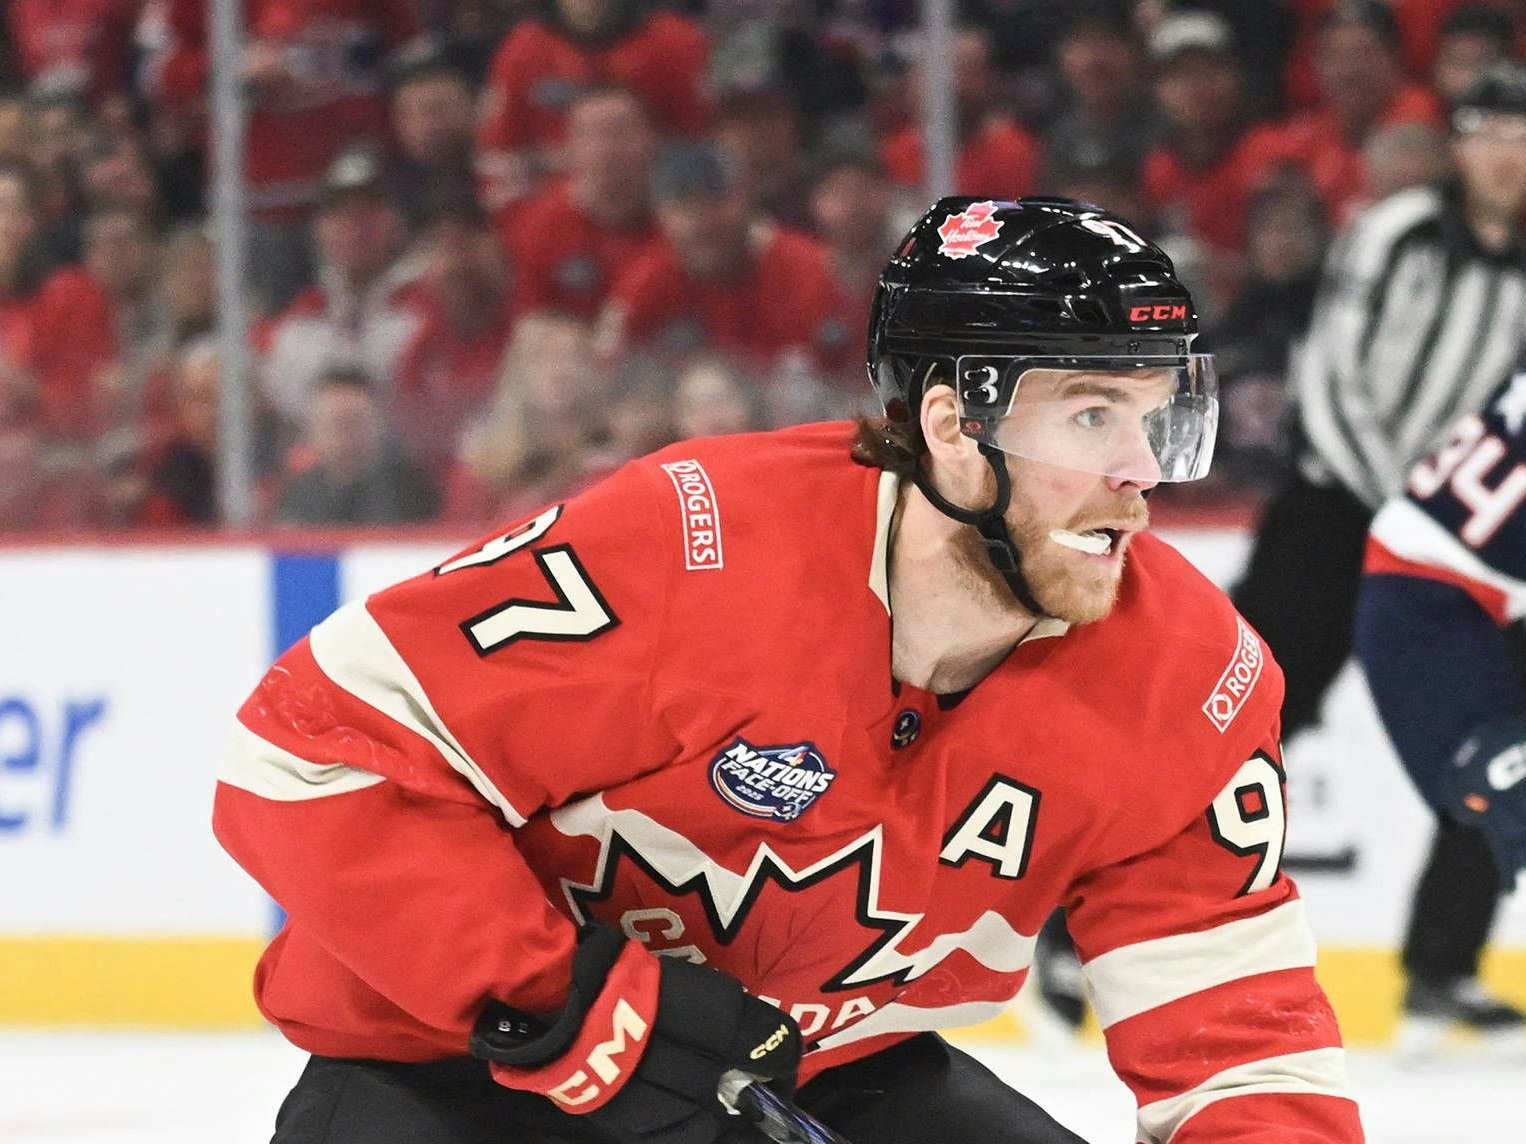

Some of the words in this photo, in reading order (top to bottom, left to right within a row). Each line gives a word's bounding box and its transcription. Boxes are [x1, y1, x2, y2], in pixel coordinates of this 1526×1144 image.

[1129, 304, 1187, 323] CCM
[677, 473, 717, 563] ROGERS
[720, 760, 814, 804] FACE-OFF
[724, 743, 835, 793] NATIONS
[939, 773, 1042, 879] A
[1205, 741, 1289, 898] 9
[749, 1023, 790, 1061] CCM
